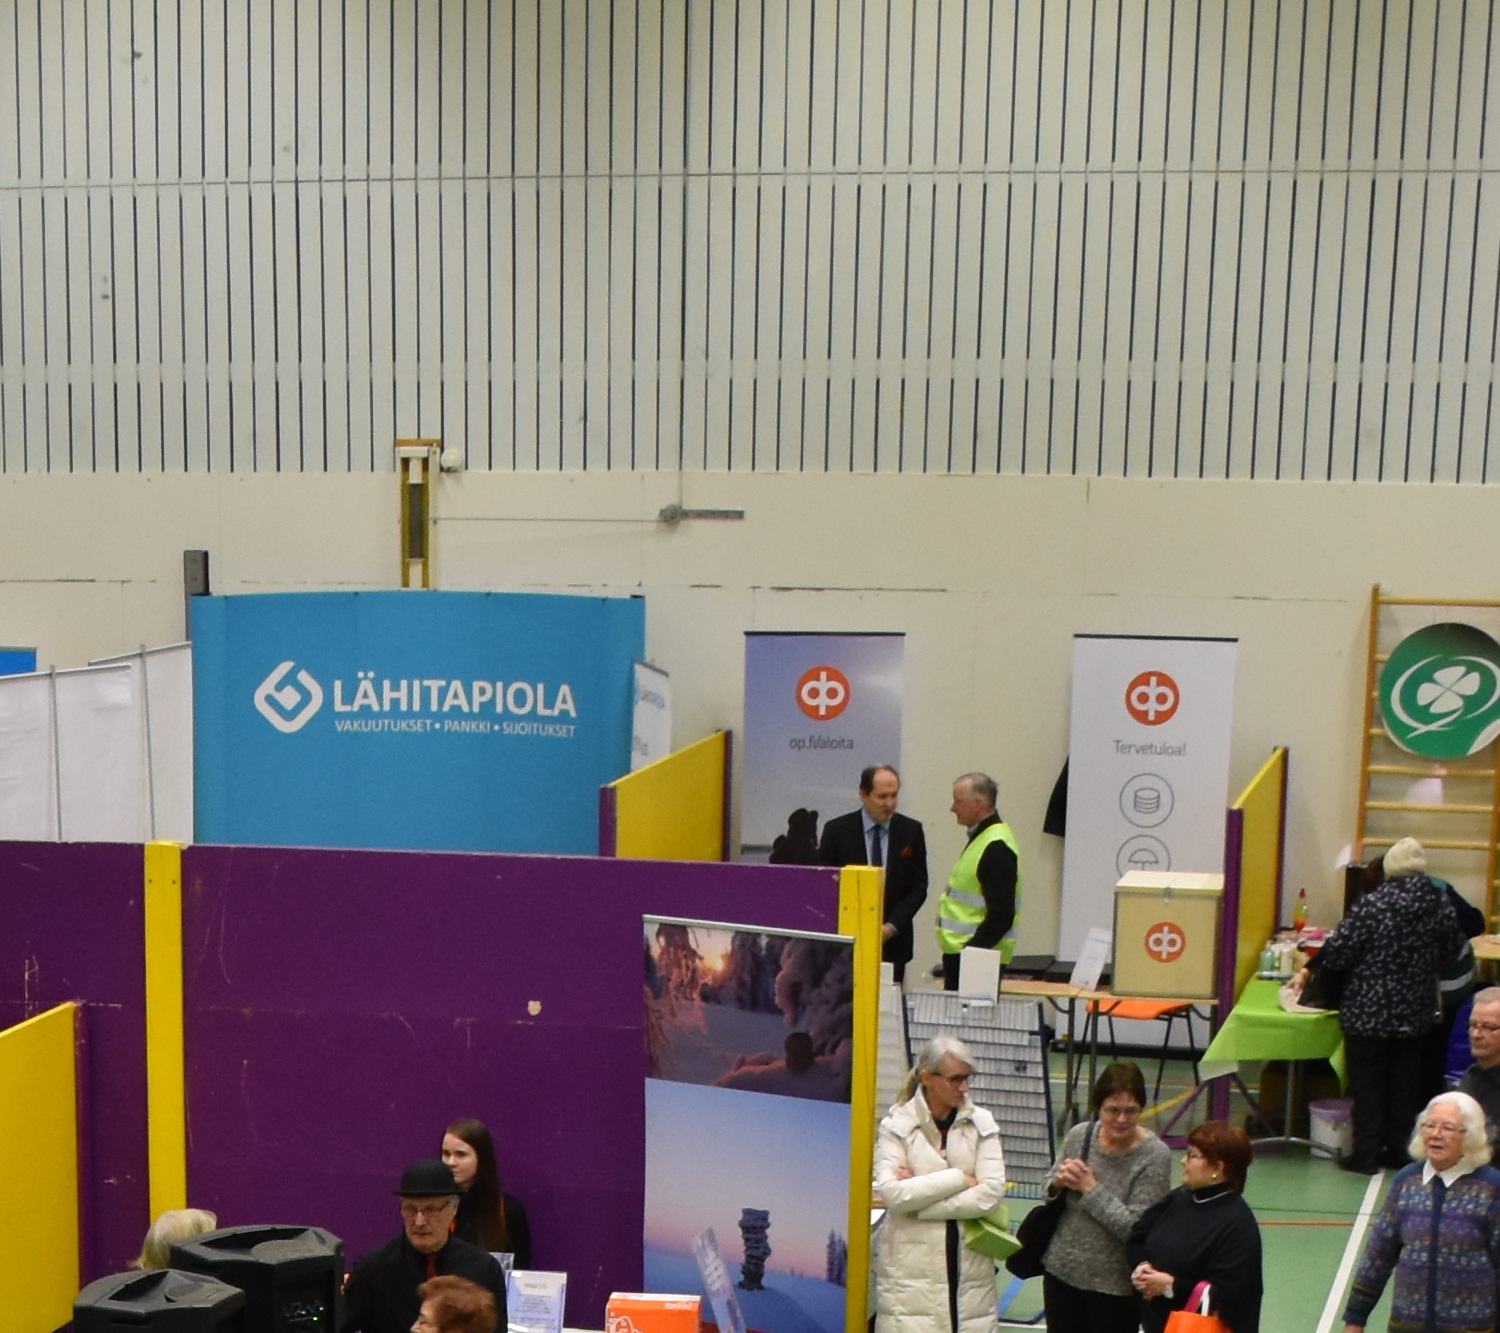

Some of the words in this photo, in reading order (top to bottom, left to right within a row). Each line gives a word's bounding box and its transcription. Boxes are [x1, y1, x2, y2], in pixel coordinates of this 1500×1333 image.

[333, 671, 577, 718] LÄHITAPIOLA
[335, 719, 431, 733] VAKUUTUKSET
[444, 720, 490, 733] PANKKI
[503, 722, 576, 738] SIJOITUKSET
[1113, 739, 1187, 757] Tervetuloa!
